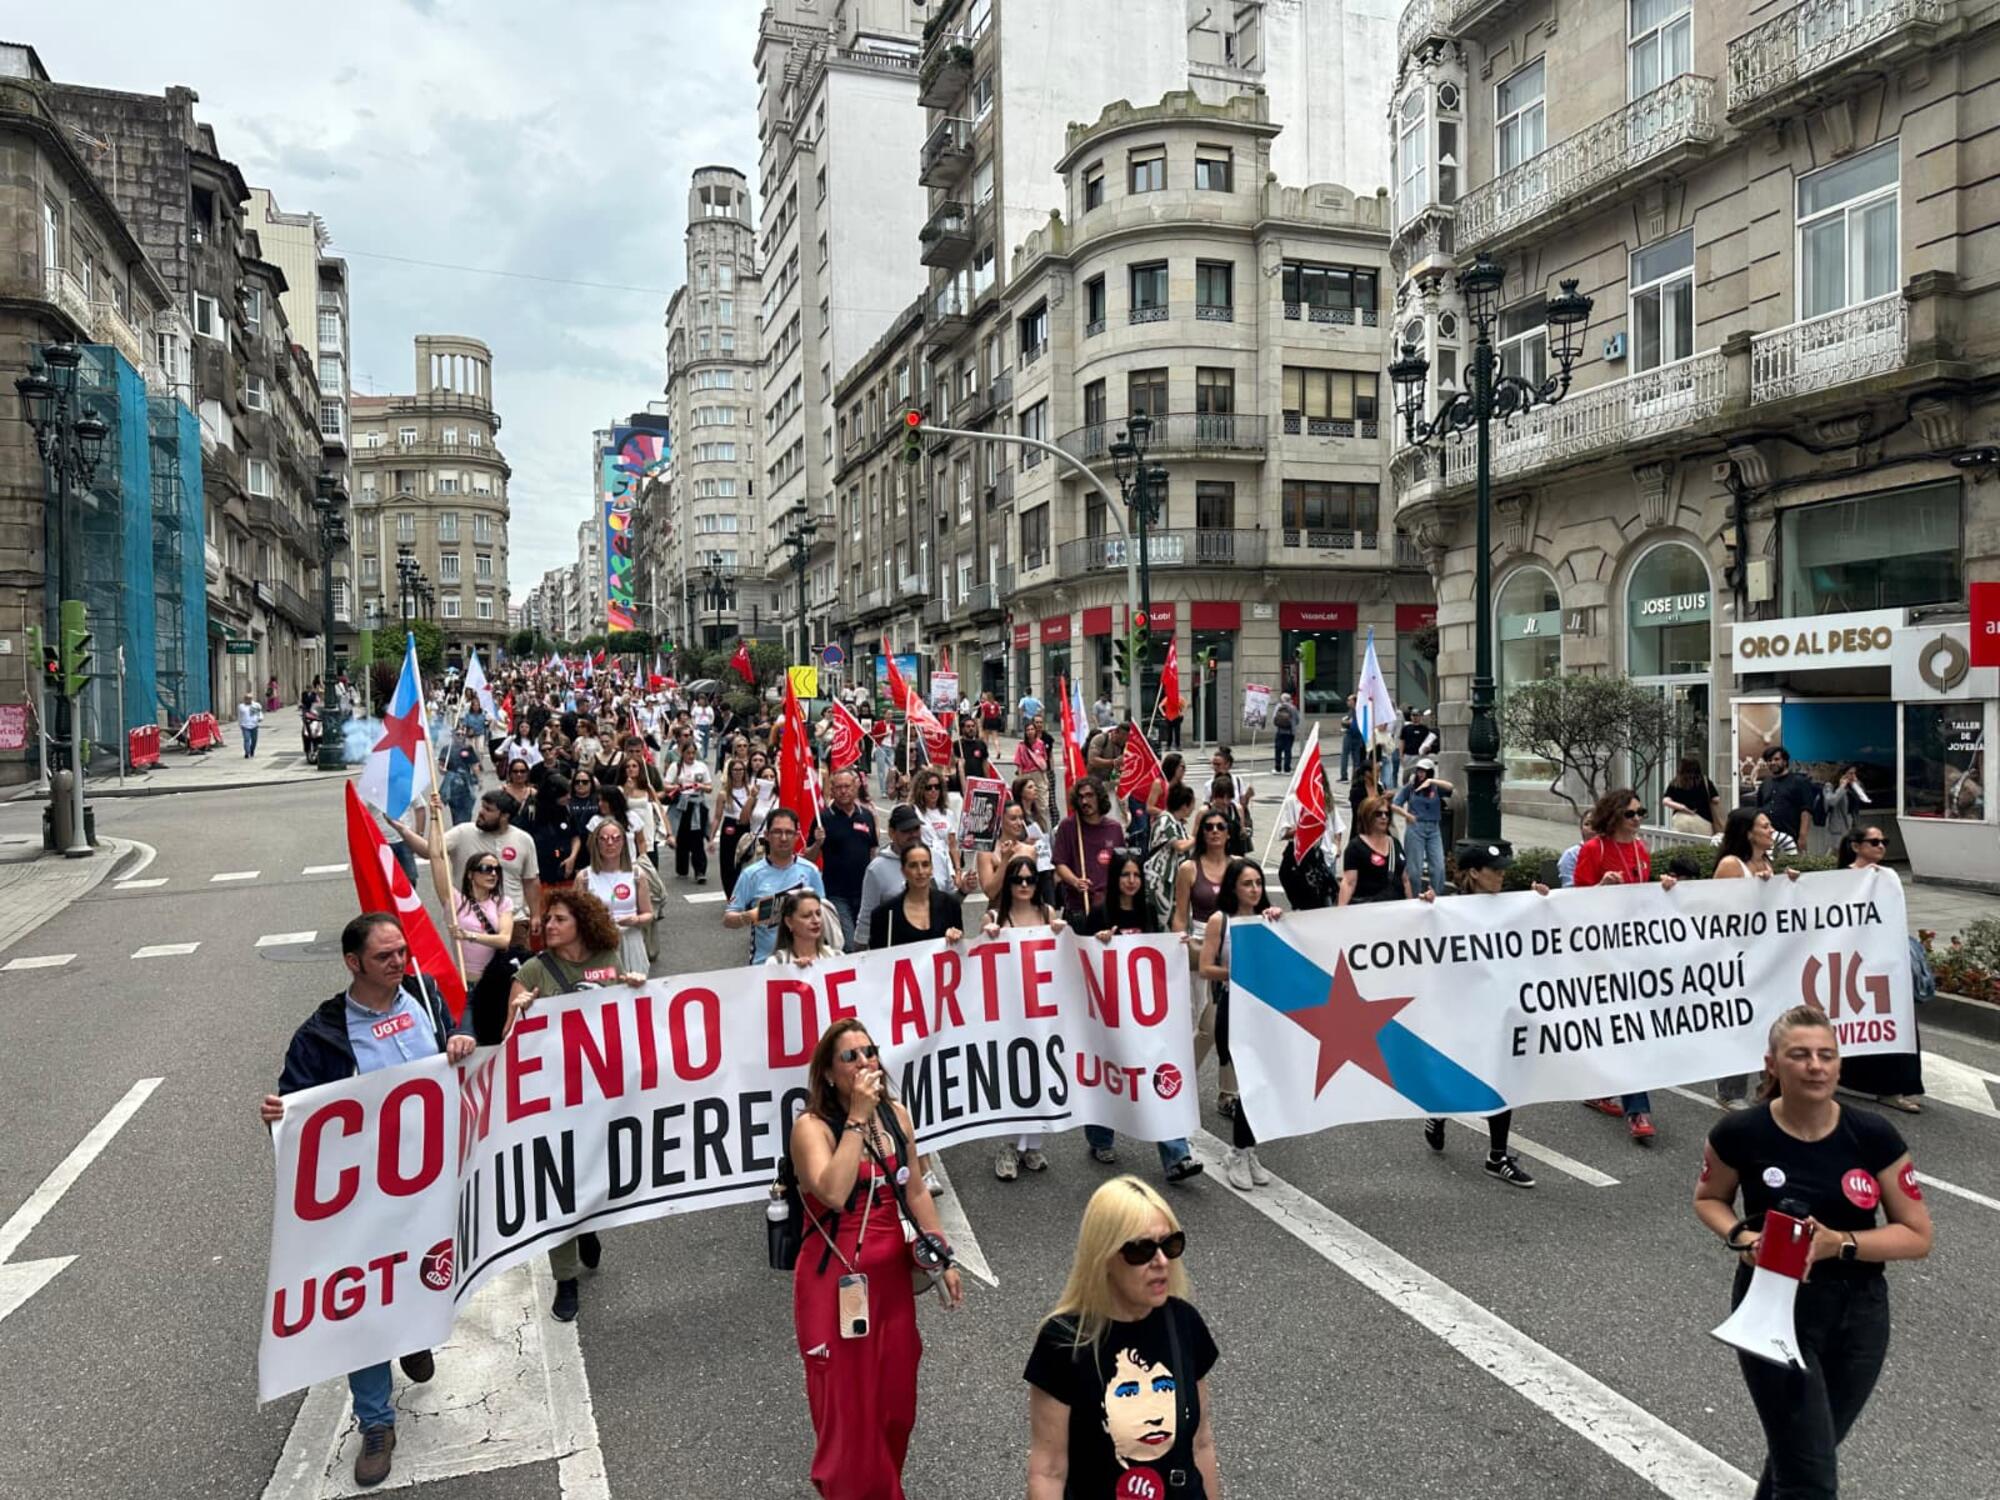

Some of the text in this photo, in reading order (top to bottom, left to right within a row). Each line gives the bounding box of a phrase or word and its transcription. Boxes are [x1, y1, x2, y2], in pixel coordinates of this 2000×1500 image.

[1641, 594, 1706, 615] JOSE LUIS
[1739, 625, 1893, 660] ORO AL PESO
[1952, 721, 1980, 730] TALLER
[1960, 732, 1971, 741] DE
[1348, 901, 1882, 971] CONVENIO DE COMERCIO VARIO EN LOITA
[584, 970, 605, 980] UGT
[891, 938, 1058, 1045] ARTE
[1078, 946, 1169, 1028] NO
[1519, 951, 1745, 1014] CONVENIOS AQUÍ
[1802, 950, 1892, 1019] CIG
[372, 1020, 400, 1038] UGT
[1512, 997, 1753, 1056] E NON EN MADRID
[1833, 1020, 1897, 1045] VIZOS
[1075, 1053, 1146, 1102] UGT
[495, 1129, 576, 1237] UN
[608, 1087, 810, 1201] DEREC
[901, 1034, 1068, 1130] MENOS
[272, 1251, 408, 1338] UGT
